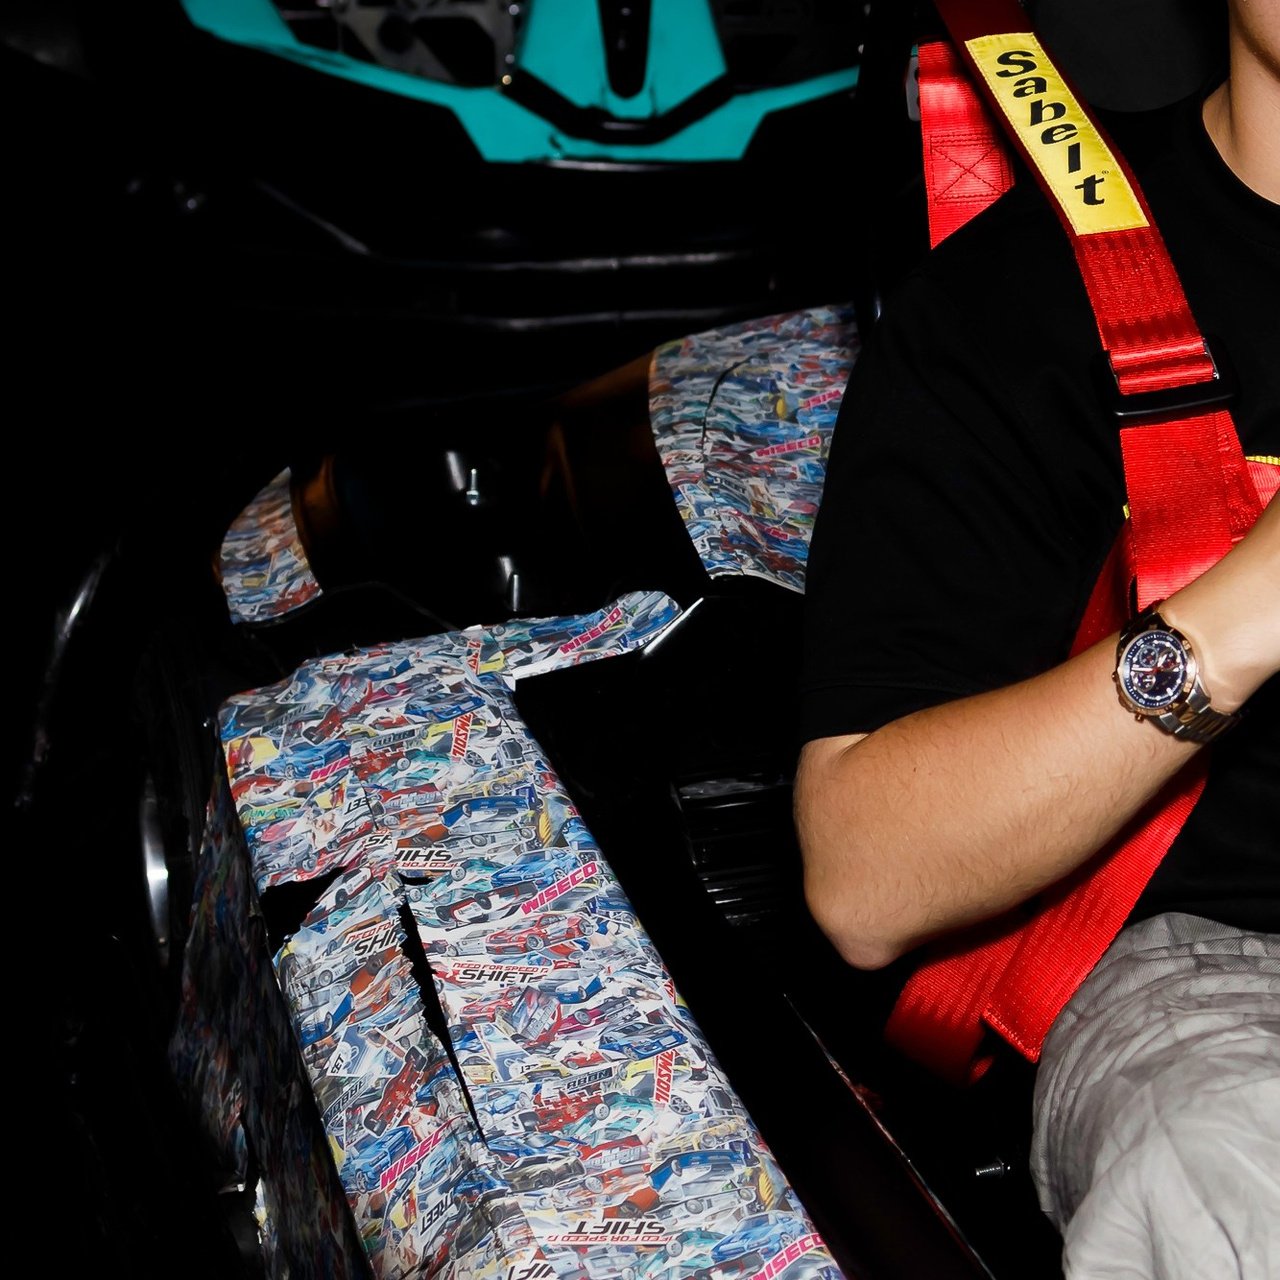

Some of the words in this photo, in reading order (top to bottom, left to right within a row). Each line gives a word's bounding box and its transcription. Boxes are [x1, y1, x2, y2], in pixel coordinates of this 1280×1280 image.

[996, 50, 1105, 206] Sabelt
[559, 606, 623, 654] WISECO
[520, 861, 599, 915] WISECO
[459, 970, 535, 984] SHIFT
[561, 1235, 608, 1243] SPEED
[568, 1220, 666, 1235] SHIFT
